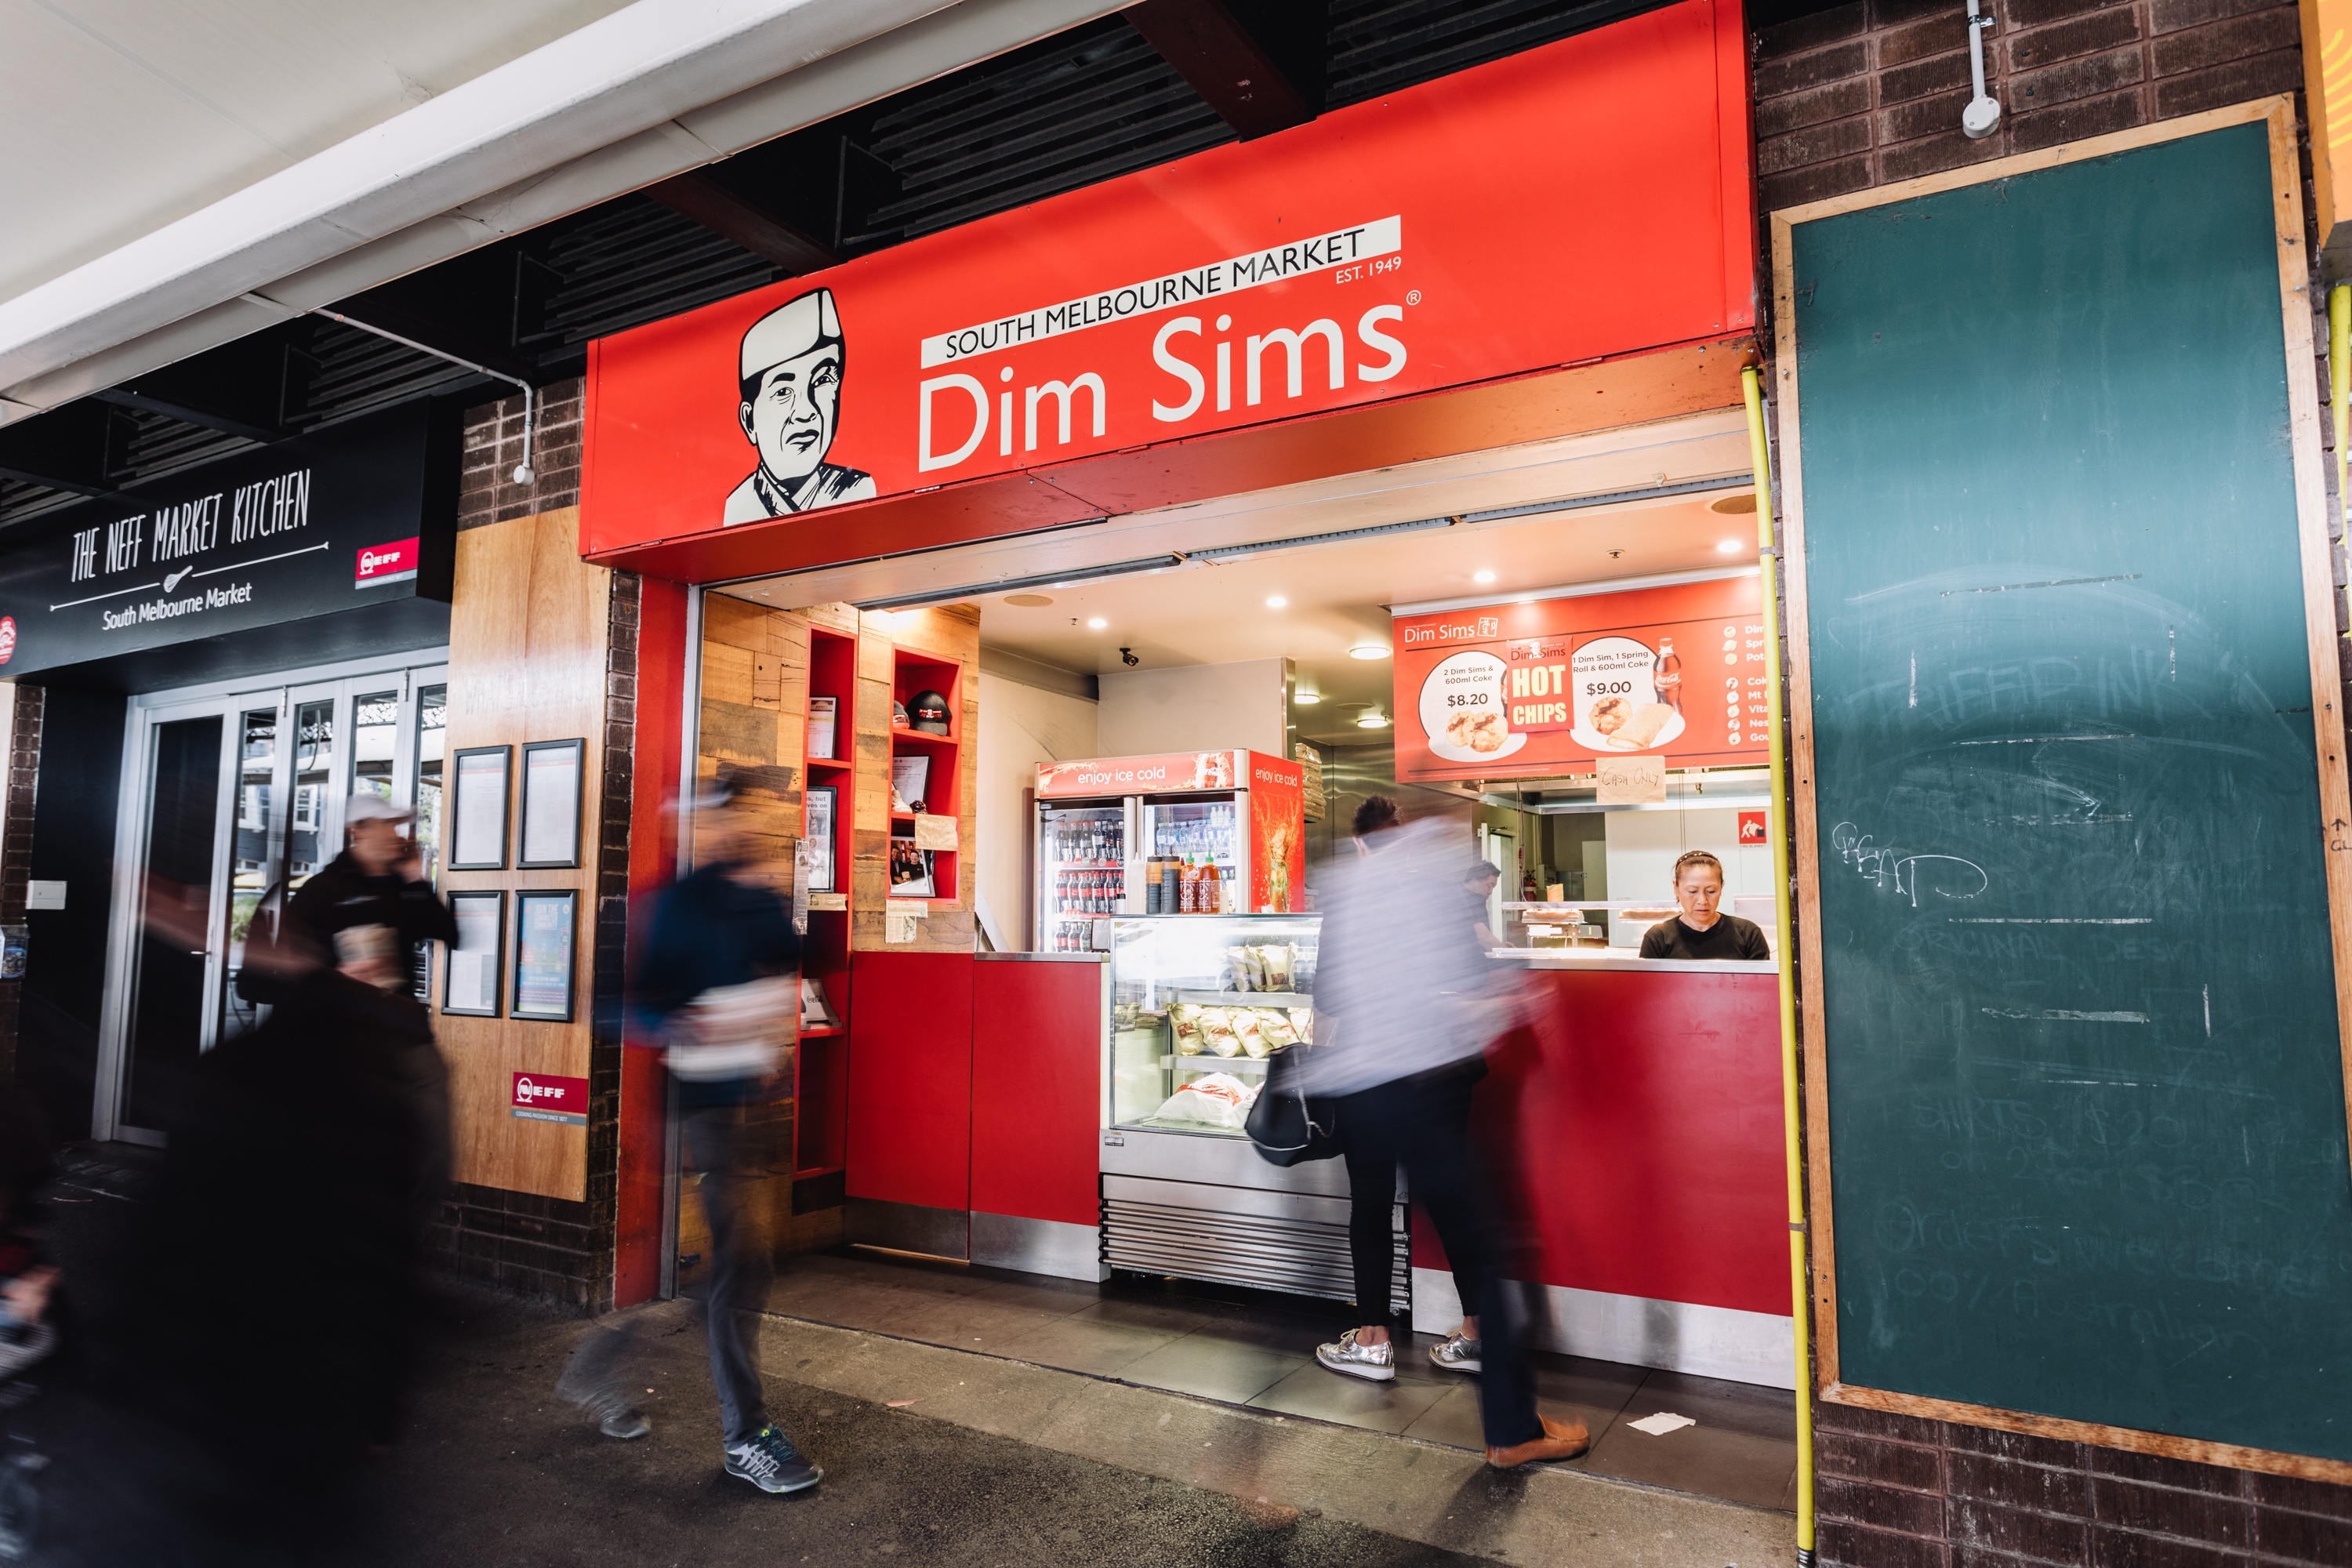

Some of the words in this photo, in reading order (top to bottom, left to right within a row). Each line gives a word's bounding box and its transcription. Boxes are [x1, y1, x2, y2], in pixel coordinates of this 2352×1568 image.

[1336, 267, 1363, 285] EST.
[1368, 256, 1402, 278] 1949
[946, 314, 1036, 358] SOUTH
[1045, 267, 1221, 334] MELBOURNE
[1232, 228, 1365, 289] MARKET
[919, 366, 1105, 473] Dim
[71, 527, 100, 583] THE
[105, 514, 147, 574] NEFF
[152, 493, 223, 563] MARKET
[230, 469, 310, 544] KITCHEN
[360, 551, 401, 575] NEFF
[102, 604, 136, 631] South
[138, 592, 203, 623] Melbourne
[205, 583, 252, 611] Market
[1405, 628, 1435, 643] Dim
[1439, 624, 1475, 639] Sims
[1541, 648, 1566, 658] Sims
[1746, 640, 1765, 649] Spr
[1621, 651, 1649, 660] Spring
[1573, 665, 1588, 673] Roll
[1599, 662, 1625, 671] 600ml
[1445, 676, 1470, 684] 600ml
[1512, 664, 1566, 698] HOT
[1587, 681, 1632, 696] $9.00
[1447, 693, 1488, 708] $8.20
[1513, 702, 1566, 725] CHIPS
[1078, 771, 1112, 785] enjoy
[1115, 768, 1134, 782] ice
[1137, 765, 1166, 780] cold
[1255, 768, 1273, 784] enjoy
[1274, 770, 1283, 784] ice
[1284, 775, 1298, 787] cold
[1602, 767, 1628, 786] CASH
[1634, 767, 1659, 786] ONLY
[517, 1077, 564, 1103] NEFF
